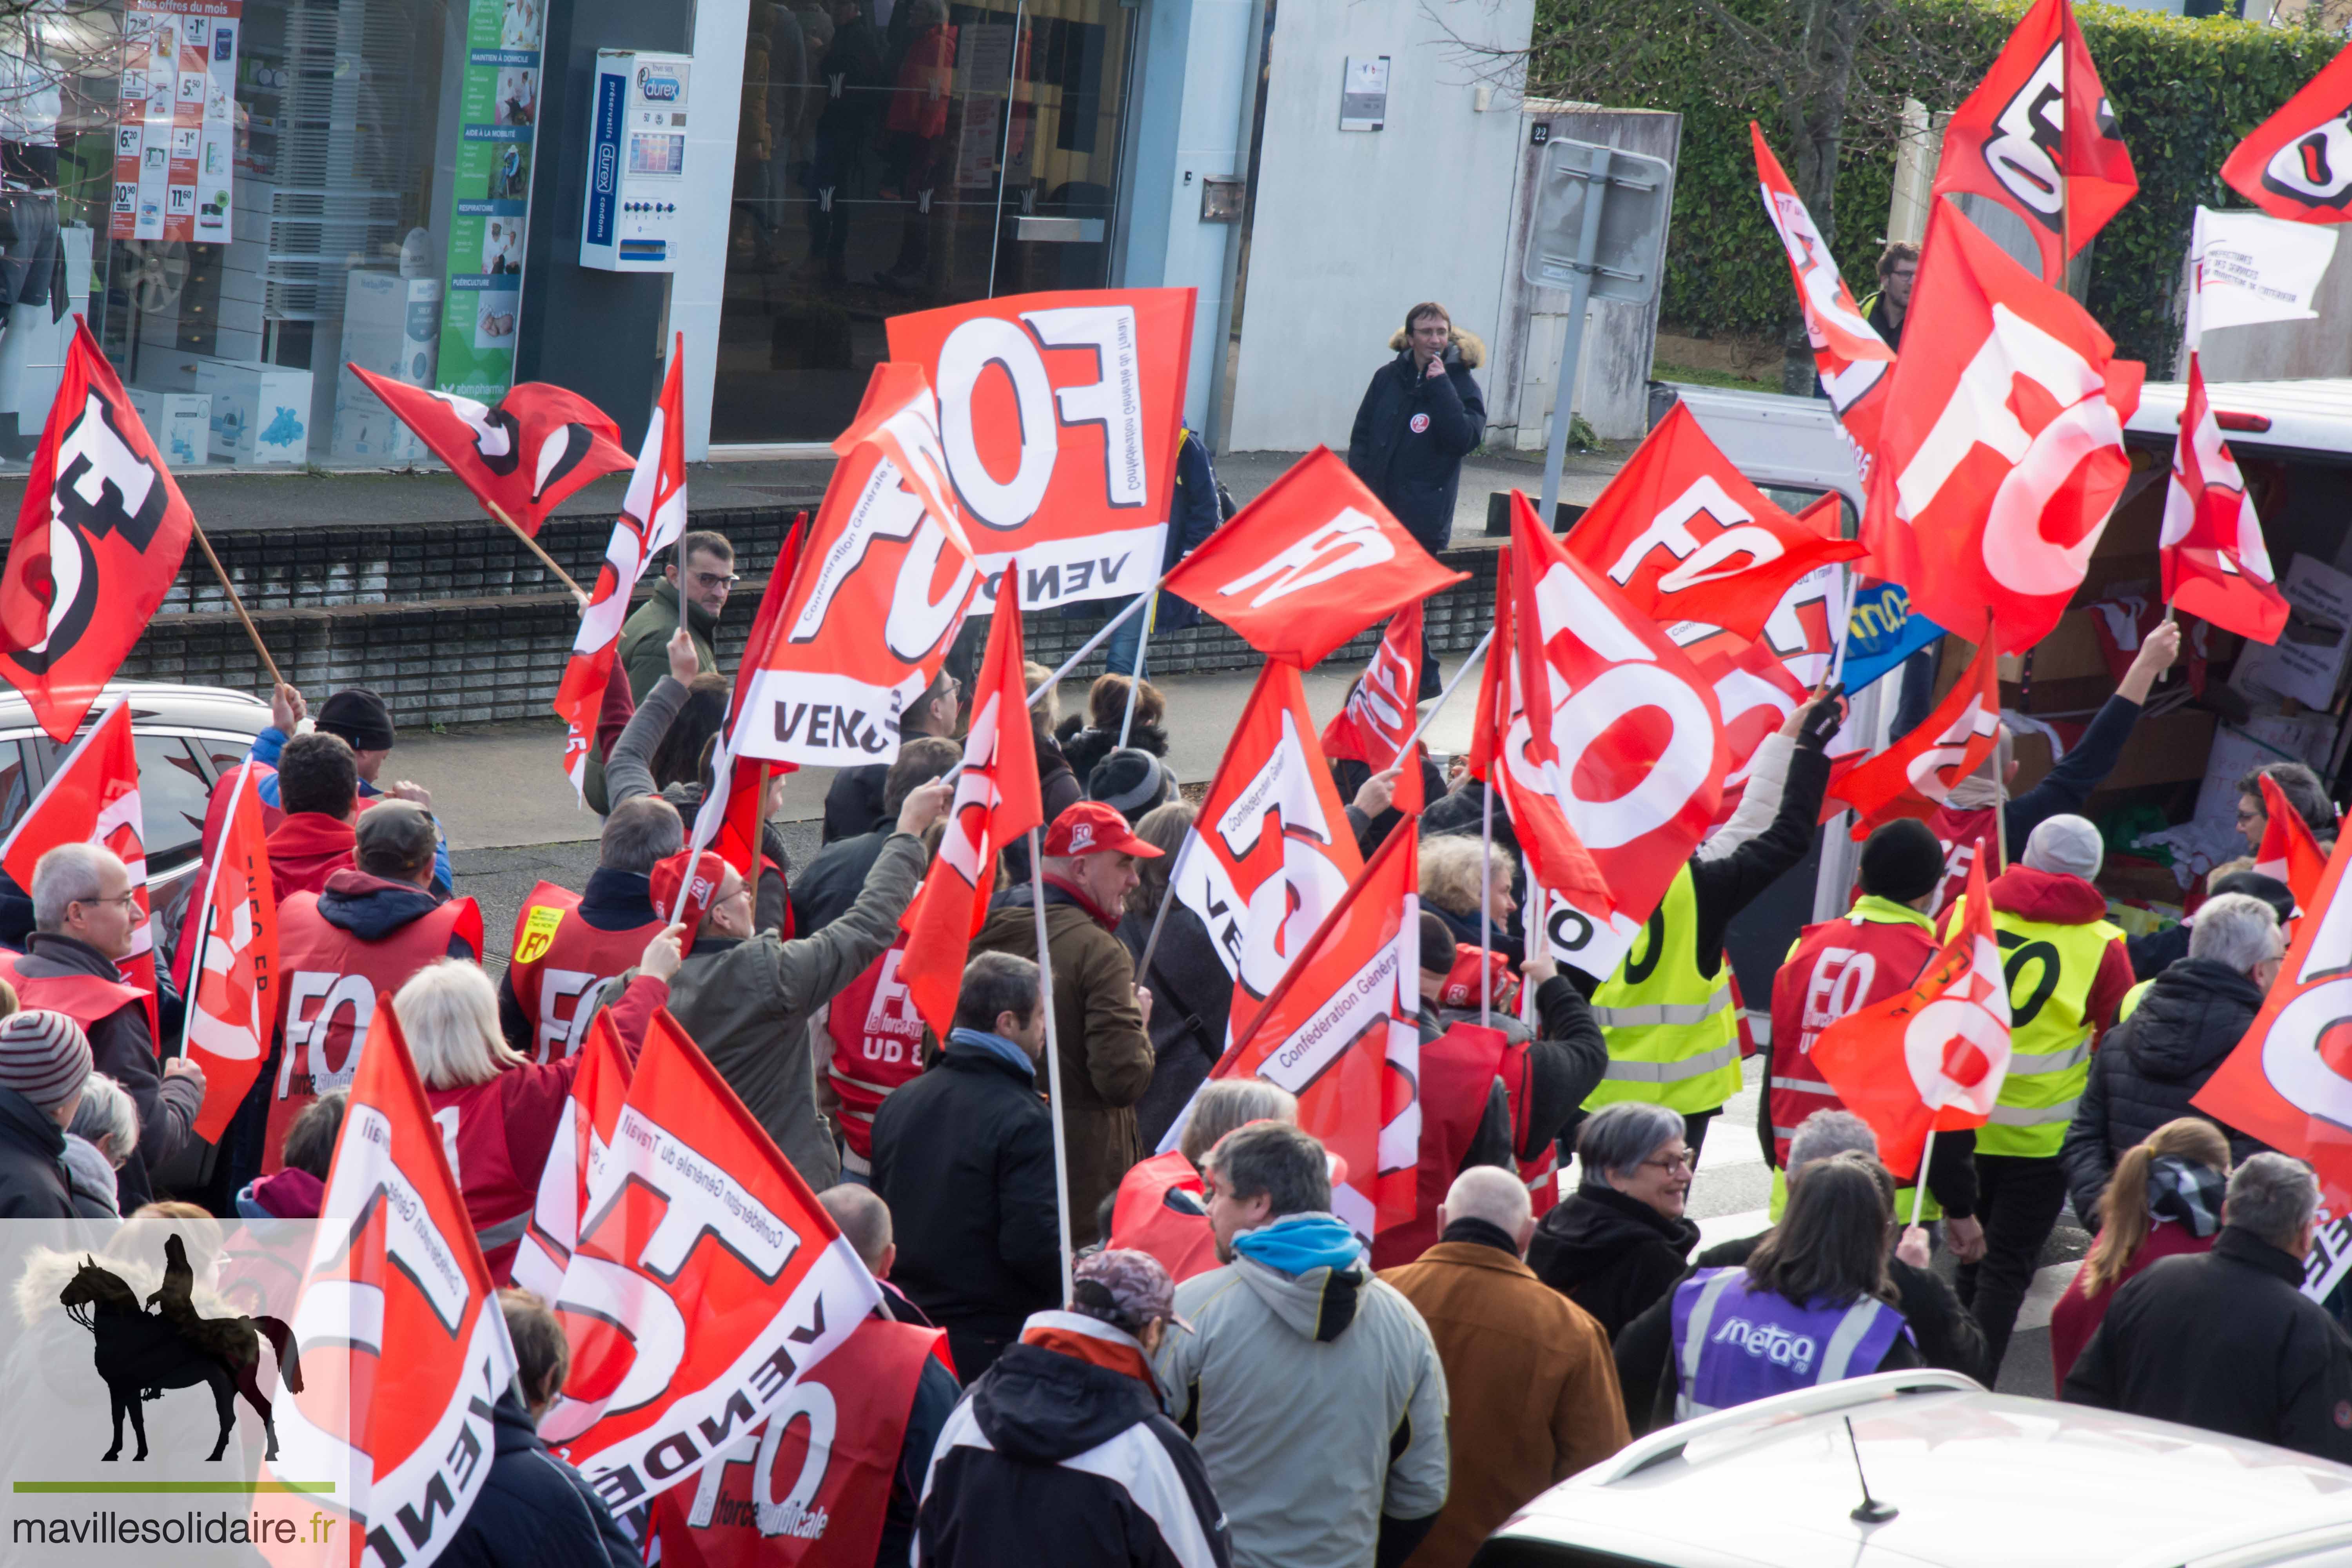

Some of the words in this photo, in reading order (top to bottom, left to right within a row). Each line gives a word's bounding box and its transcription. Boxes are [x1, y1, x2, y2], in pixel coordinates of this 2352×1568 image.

[159, 0, 187, 12] offres
[191, 2, 201, 12] du
[205, 4, 227, 14] mois
[472, 53, 497, 62] MAINTIEN
[498, 53, 502, 62] À
[606, 81, 615, 139] préservatifs
[647, 80, 678, 98] durex
[492, 129, 516, 138] MOBILITÉ
[1534, 127, 1546, 140] 22
[599, 146, 614, 189] durex
[597, 197, 606, 238] condoms
[1896, 302, 2131, 596] FO
[803, 532, 857, 622] Confédération
[853, 470, 888, 529] Générale
[1607, 474, 1784, 593] FO
[1073, 824, 1092, 841] FO
[520, 932, 549, 959] FO
[1802, 947, 1876, 1029] FO
[278, 970, 377, 1101] FO
[863, 1036, 903, 1063] UD
[911, 1044, 923, 1066] 8
[1279, 990, 1360, 1069] Confédération
[687, 1381, 837, 1536] FO
[716, 1490, 760, 1527] force
[758, 1499, 829, 1540] syndicale
